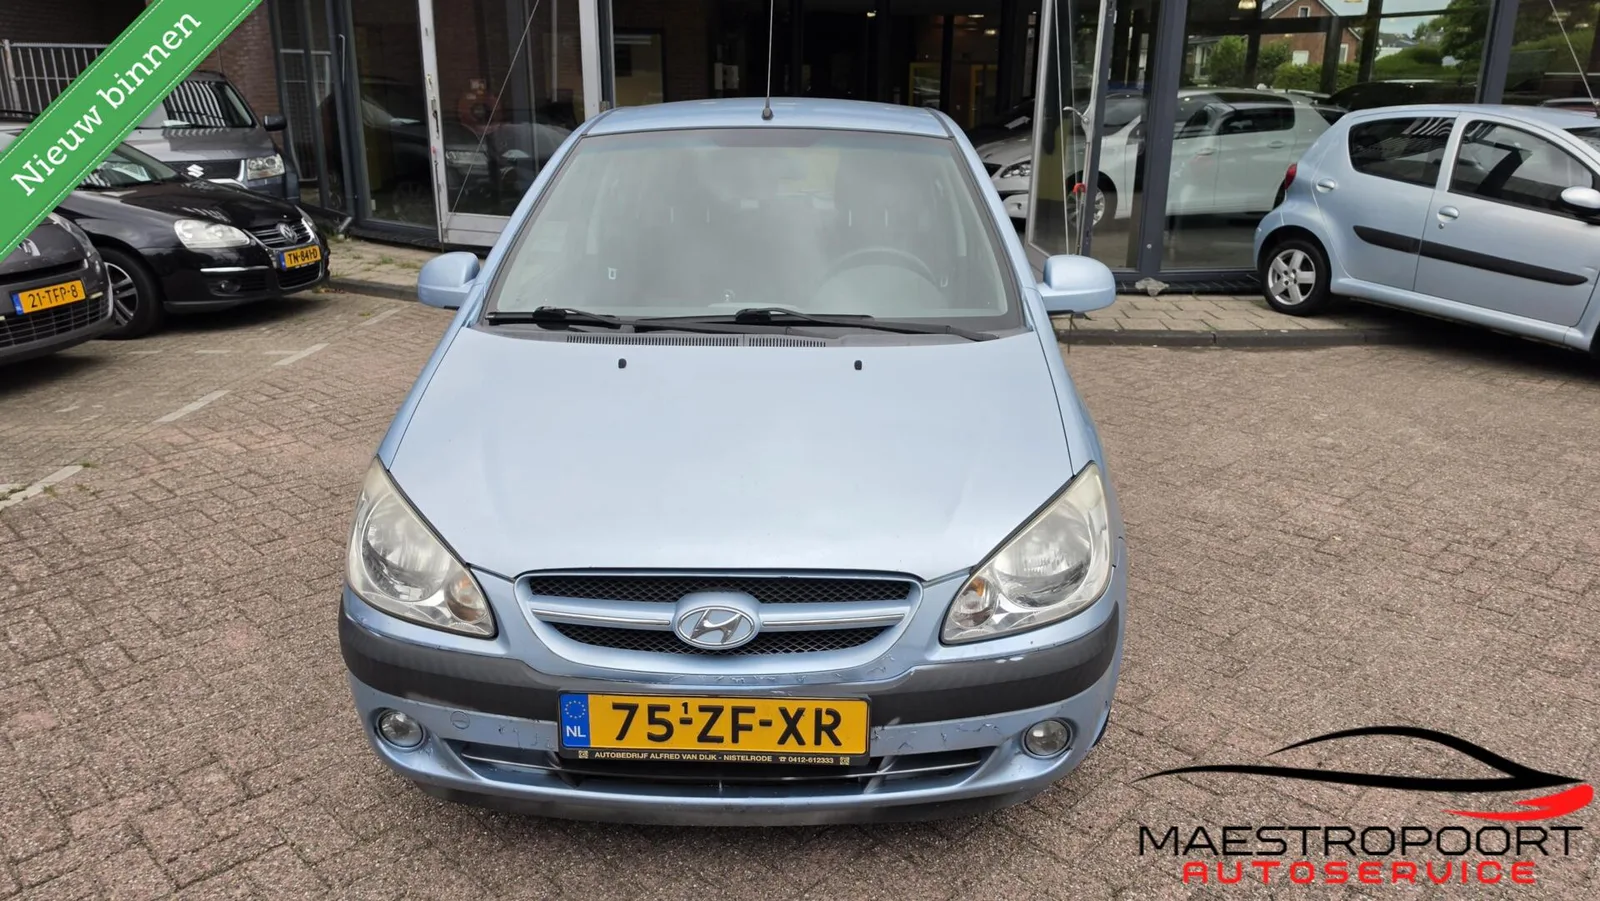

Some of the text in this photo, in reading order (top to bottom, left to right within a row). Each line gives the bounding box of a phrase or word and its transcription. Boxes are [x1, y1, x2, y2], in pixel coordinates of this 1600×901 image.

[28, 284, 79, 308] 21-TFP-8
[566, 725, 586, 738] NL
[594, 751, 649, 760] AUTOBEDRIJF
[649, 752, 681, 760] ALFRED
[699, 753, 717, 761] DIJK
[723, 754, 773, 762] NISTELRODE
[787, 756, 834, 764] 0412-612333
